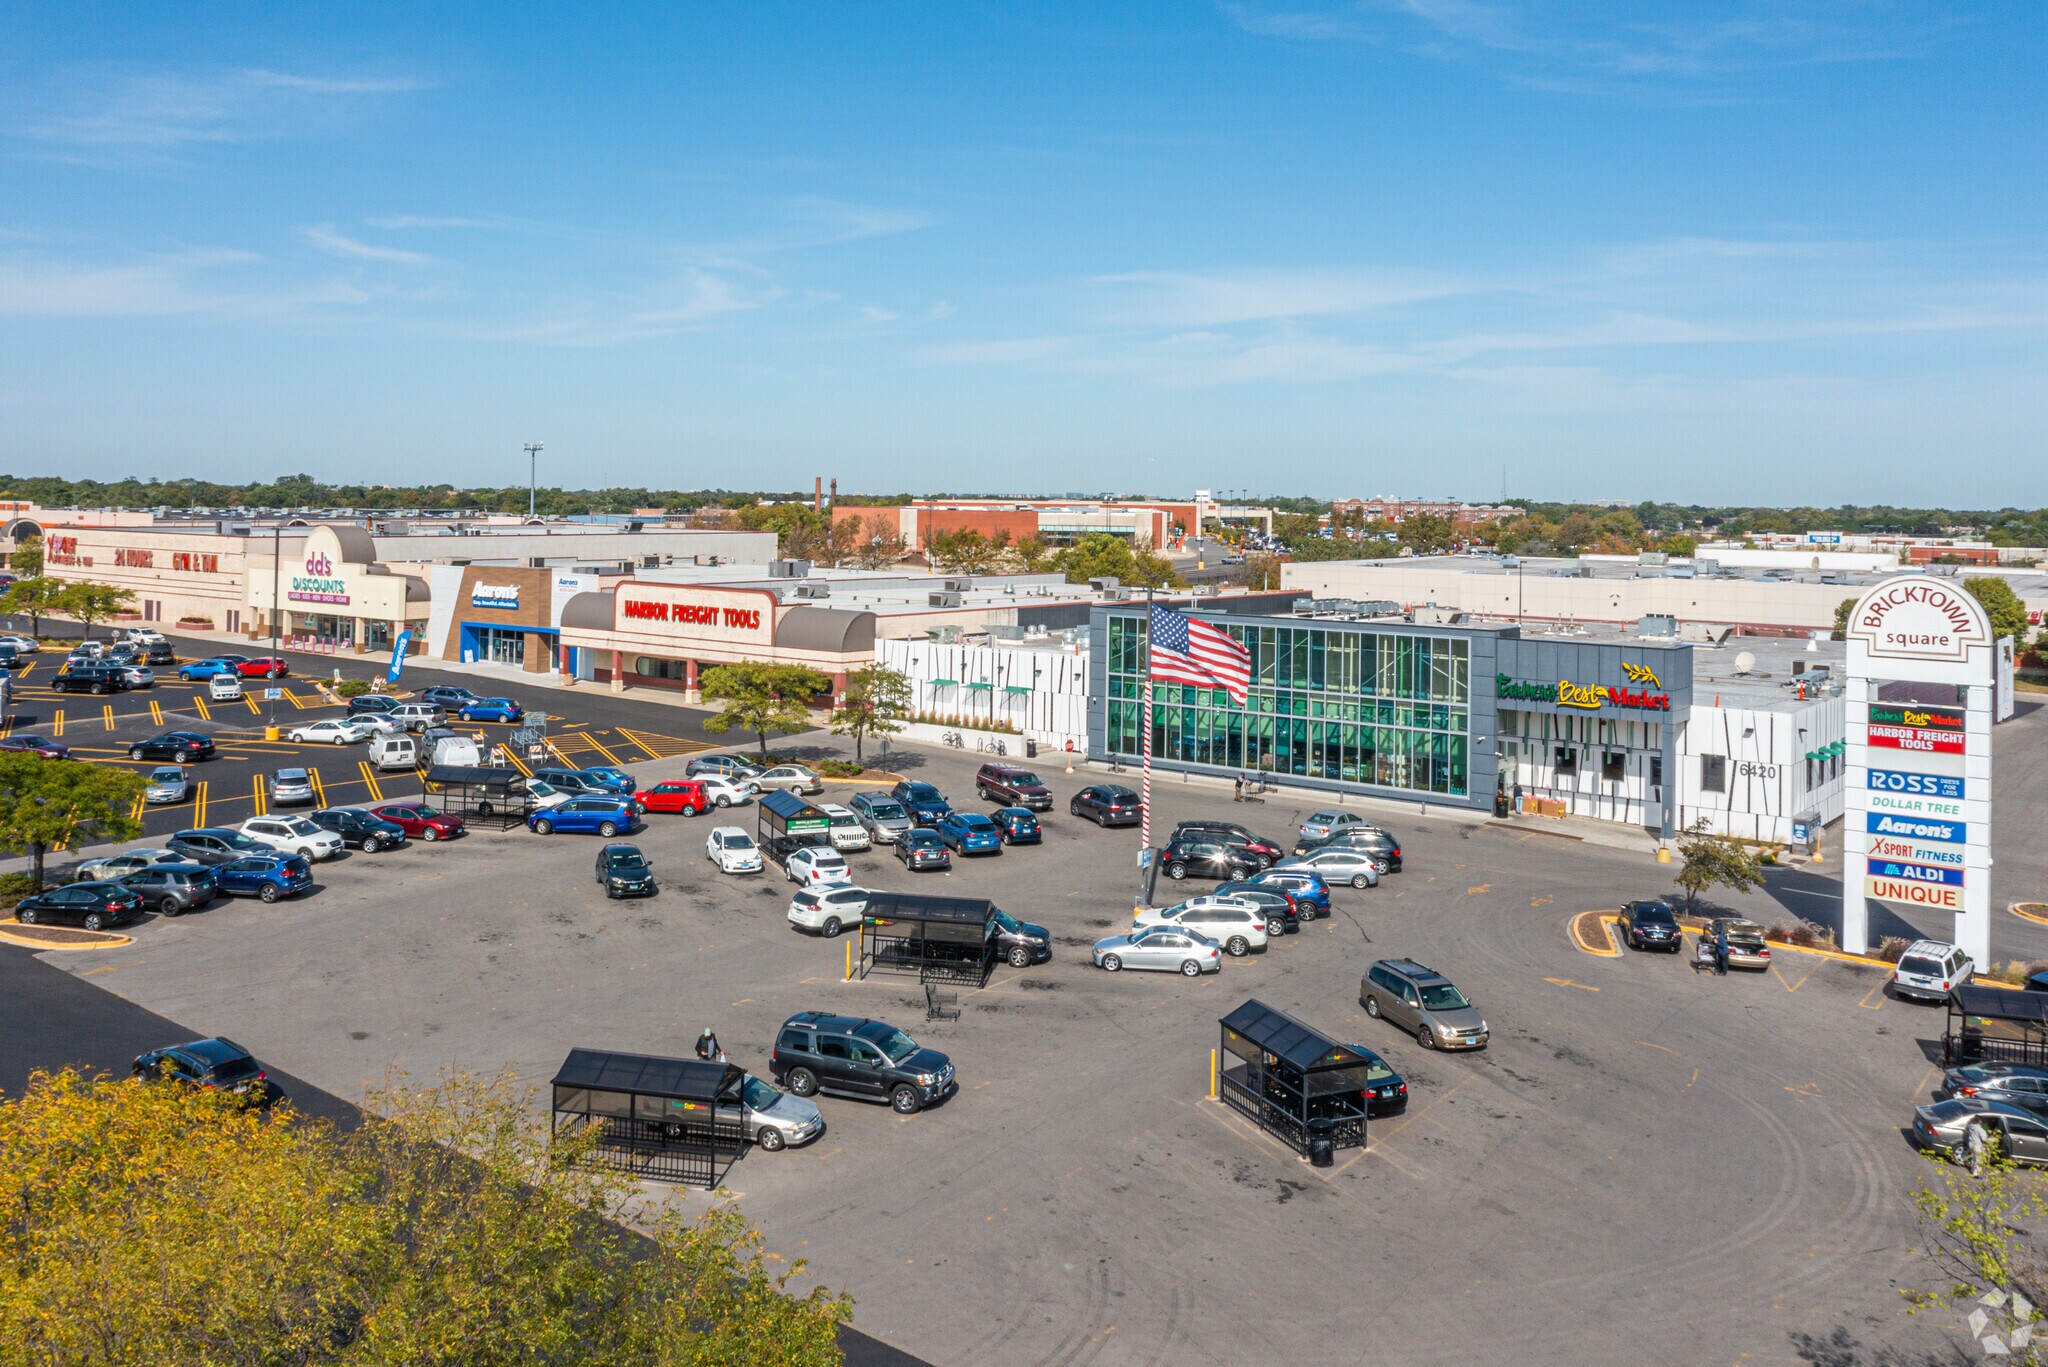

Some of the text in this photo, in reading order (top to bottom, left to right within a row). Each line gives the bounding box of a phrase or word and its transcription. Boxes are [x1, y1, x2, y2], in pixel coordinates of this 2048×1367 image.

[114, 548, 154, 569] 24 HOURS
[172, 552, 218, 573] GYM & TAN
[306, 551, 332, 577] dd's
[293, 577, 344, 593] DISCOUNTS
[472, 580, 520, 600] Aaron's
[625, 600, 761, 630] HARBOR FREIGHT TOOLS
[1863, 586, 1972, 633] BRICKTOWN
[1886, 633, 1949, 647] square
[1557, 679, 1609, 709] Best
[1608, 686, 1671, 711] Market
[1903, 710, 1931, 726] Best
[1930, 714, 1963, 727] Market
[1869, 726, 1964, 744] HARBOR FREIGHT
[1899, 738, 1934, 751] TOOLS
[1740, 763, 1776, 779] 6420
[1872, 771, 1938, 794] ROSS
[1872, 796, 1960, 815] DOLLAR TREE
[1876, 816, 1953, 839] Aaron's
[1915, 849, 1963, 863] FITNESS
[1902, 865, 1944, 882] ALDI
[1873, 880, 1956, 907] UNIQUE
